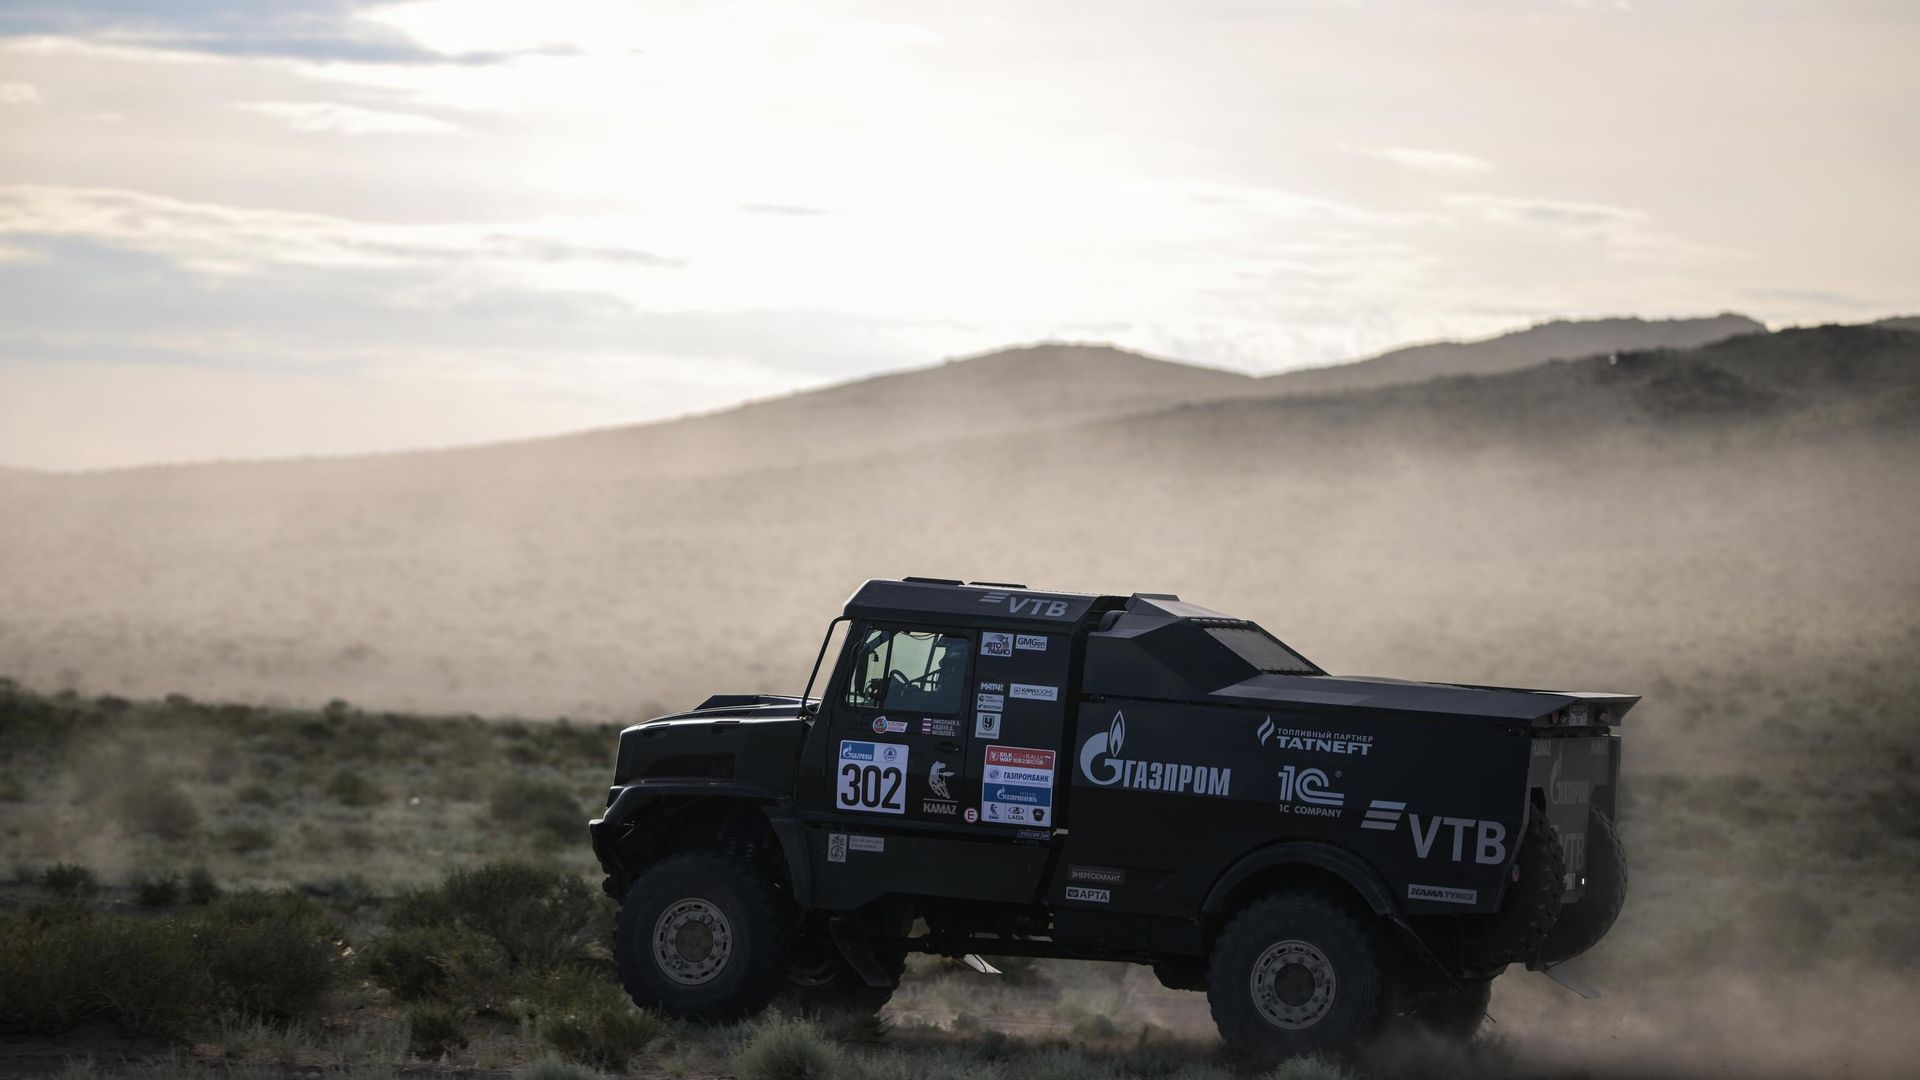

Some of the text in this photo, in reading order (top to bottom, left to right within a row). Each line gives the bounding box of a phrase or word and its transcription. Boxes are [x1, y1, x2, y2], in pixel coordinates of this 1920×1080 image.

[1009, 597, 1068, 617] VTB
[1277, 728, 1374, 743] ТОПЛИВНЫЙ ПАРТНЕР
[1276, 735, 1373, 756] TATNEFT
[1003, 771, 1049, 783] ГАЗПРОМБАНК
[1122, 759, 1232, 797] ГАЗПРОМ
[841, 763, 902, 810] 302
[923, 802, 957, 816] KAMAZ
[1294, 805, 1343, 818] COMPANY
[1008, 814, 1025, 822] LADA
[1408, 813, 1506, 865] VTB
[1071, 870, 1121, 882] ЭНЕРГОГАРАНТ
